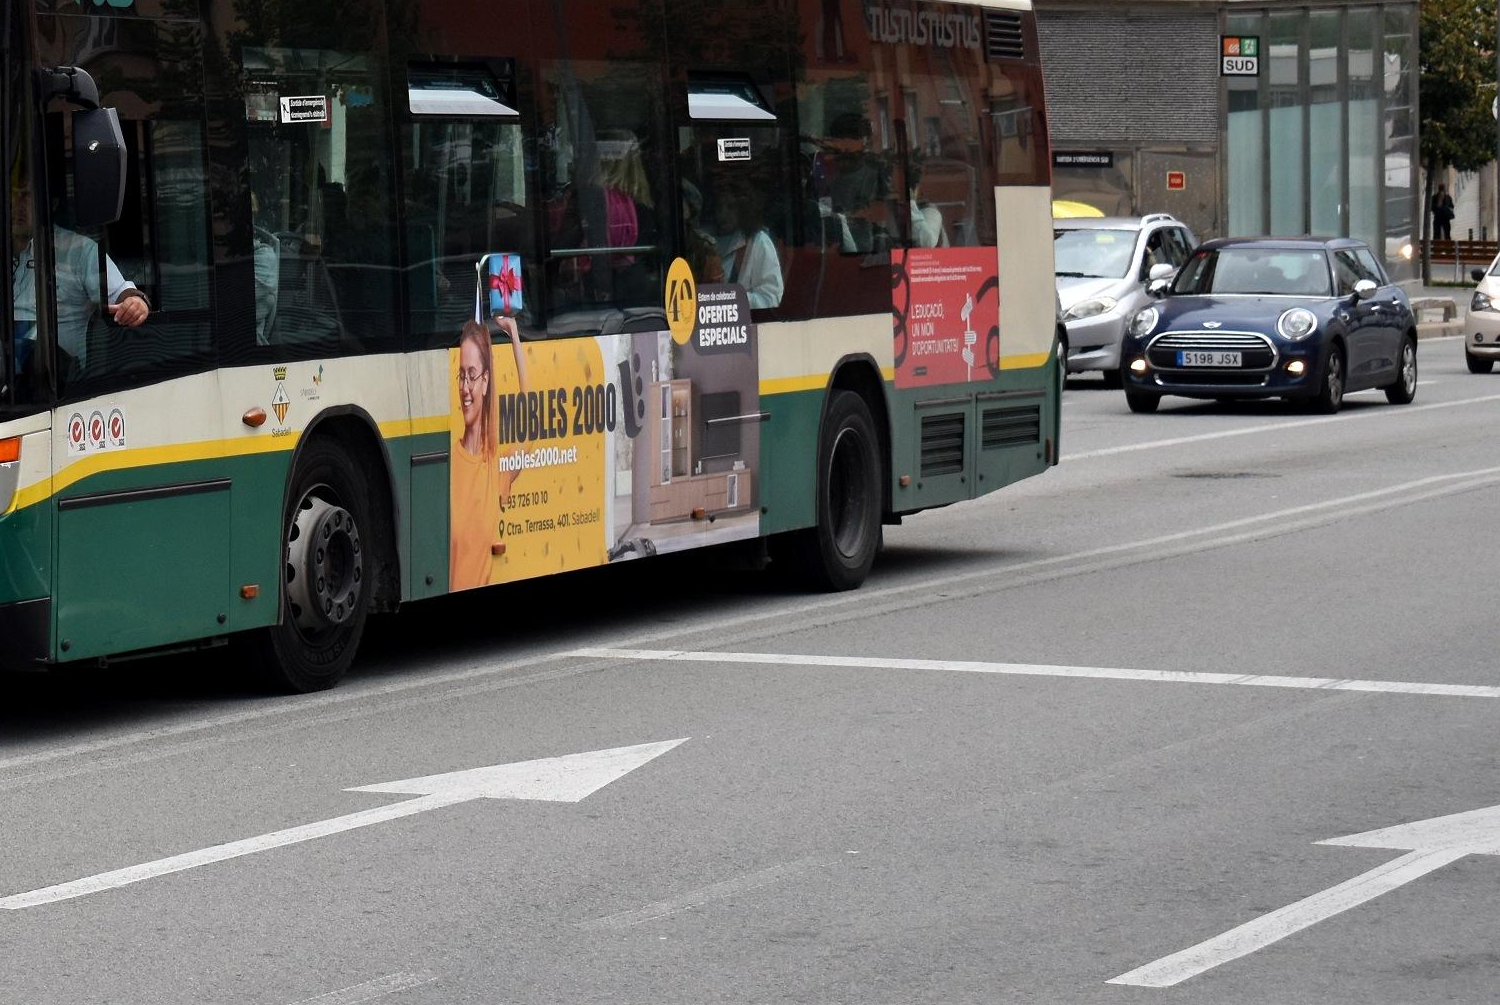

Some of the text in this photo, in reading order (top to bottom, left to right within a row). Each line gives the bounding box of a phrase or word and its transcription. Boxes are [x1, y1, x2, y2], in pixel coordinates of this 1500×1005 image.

[1226, 59, 1254, 71] SUD
[699, 304, 739, 324] OFERTES
[699, 325, 747, 347] ESPECIALS
[1185, 353, 1238, 365] 5198 JSX
[498, 382, 617, 445] MOBLES 2000
[499, 445, 578, 472] mobles2000.net
[507, 490, 549, 510] 93 726 10 10
[506, 522, 524, 536] Ctra.
[525, 519, 556, 533] Terrassa,
